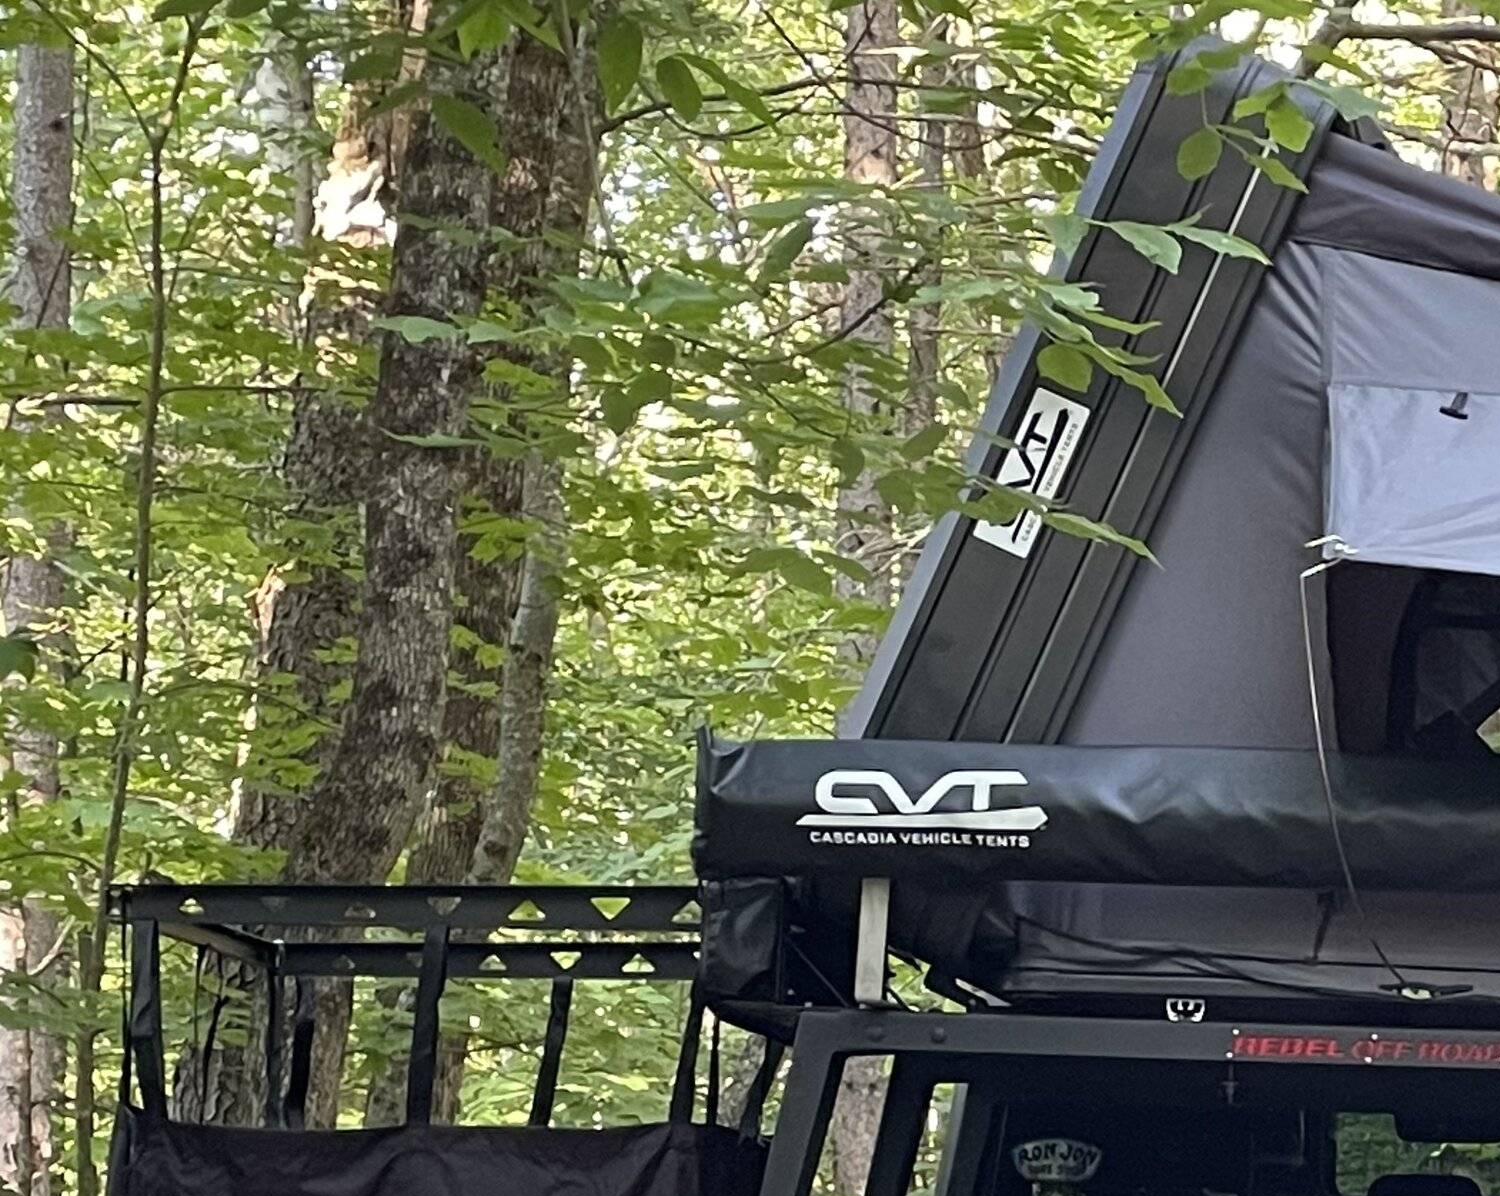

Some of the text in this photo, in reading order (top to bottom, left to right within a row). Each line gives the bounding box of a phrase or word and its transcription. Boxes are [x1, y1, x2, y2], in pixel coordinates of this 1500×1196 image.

[989, 411, 1047, 527] VT
[815, 770, 1028, 815] CVT
[810, 831, 1030, 847] CASCADIA VEHICLE TENTS
[1233, 1035, 1344, 1058] REBEL
[1352, 1040, 1413, 1060] OFF
